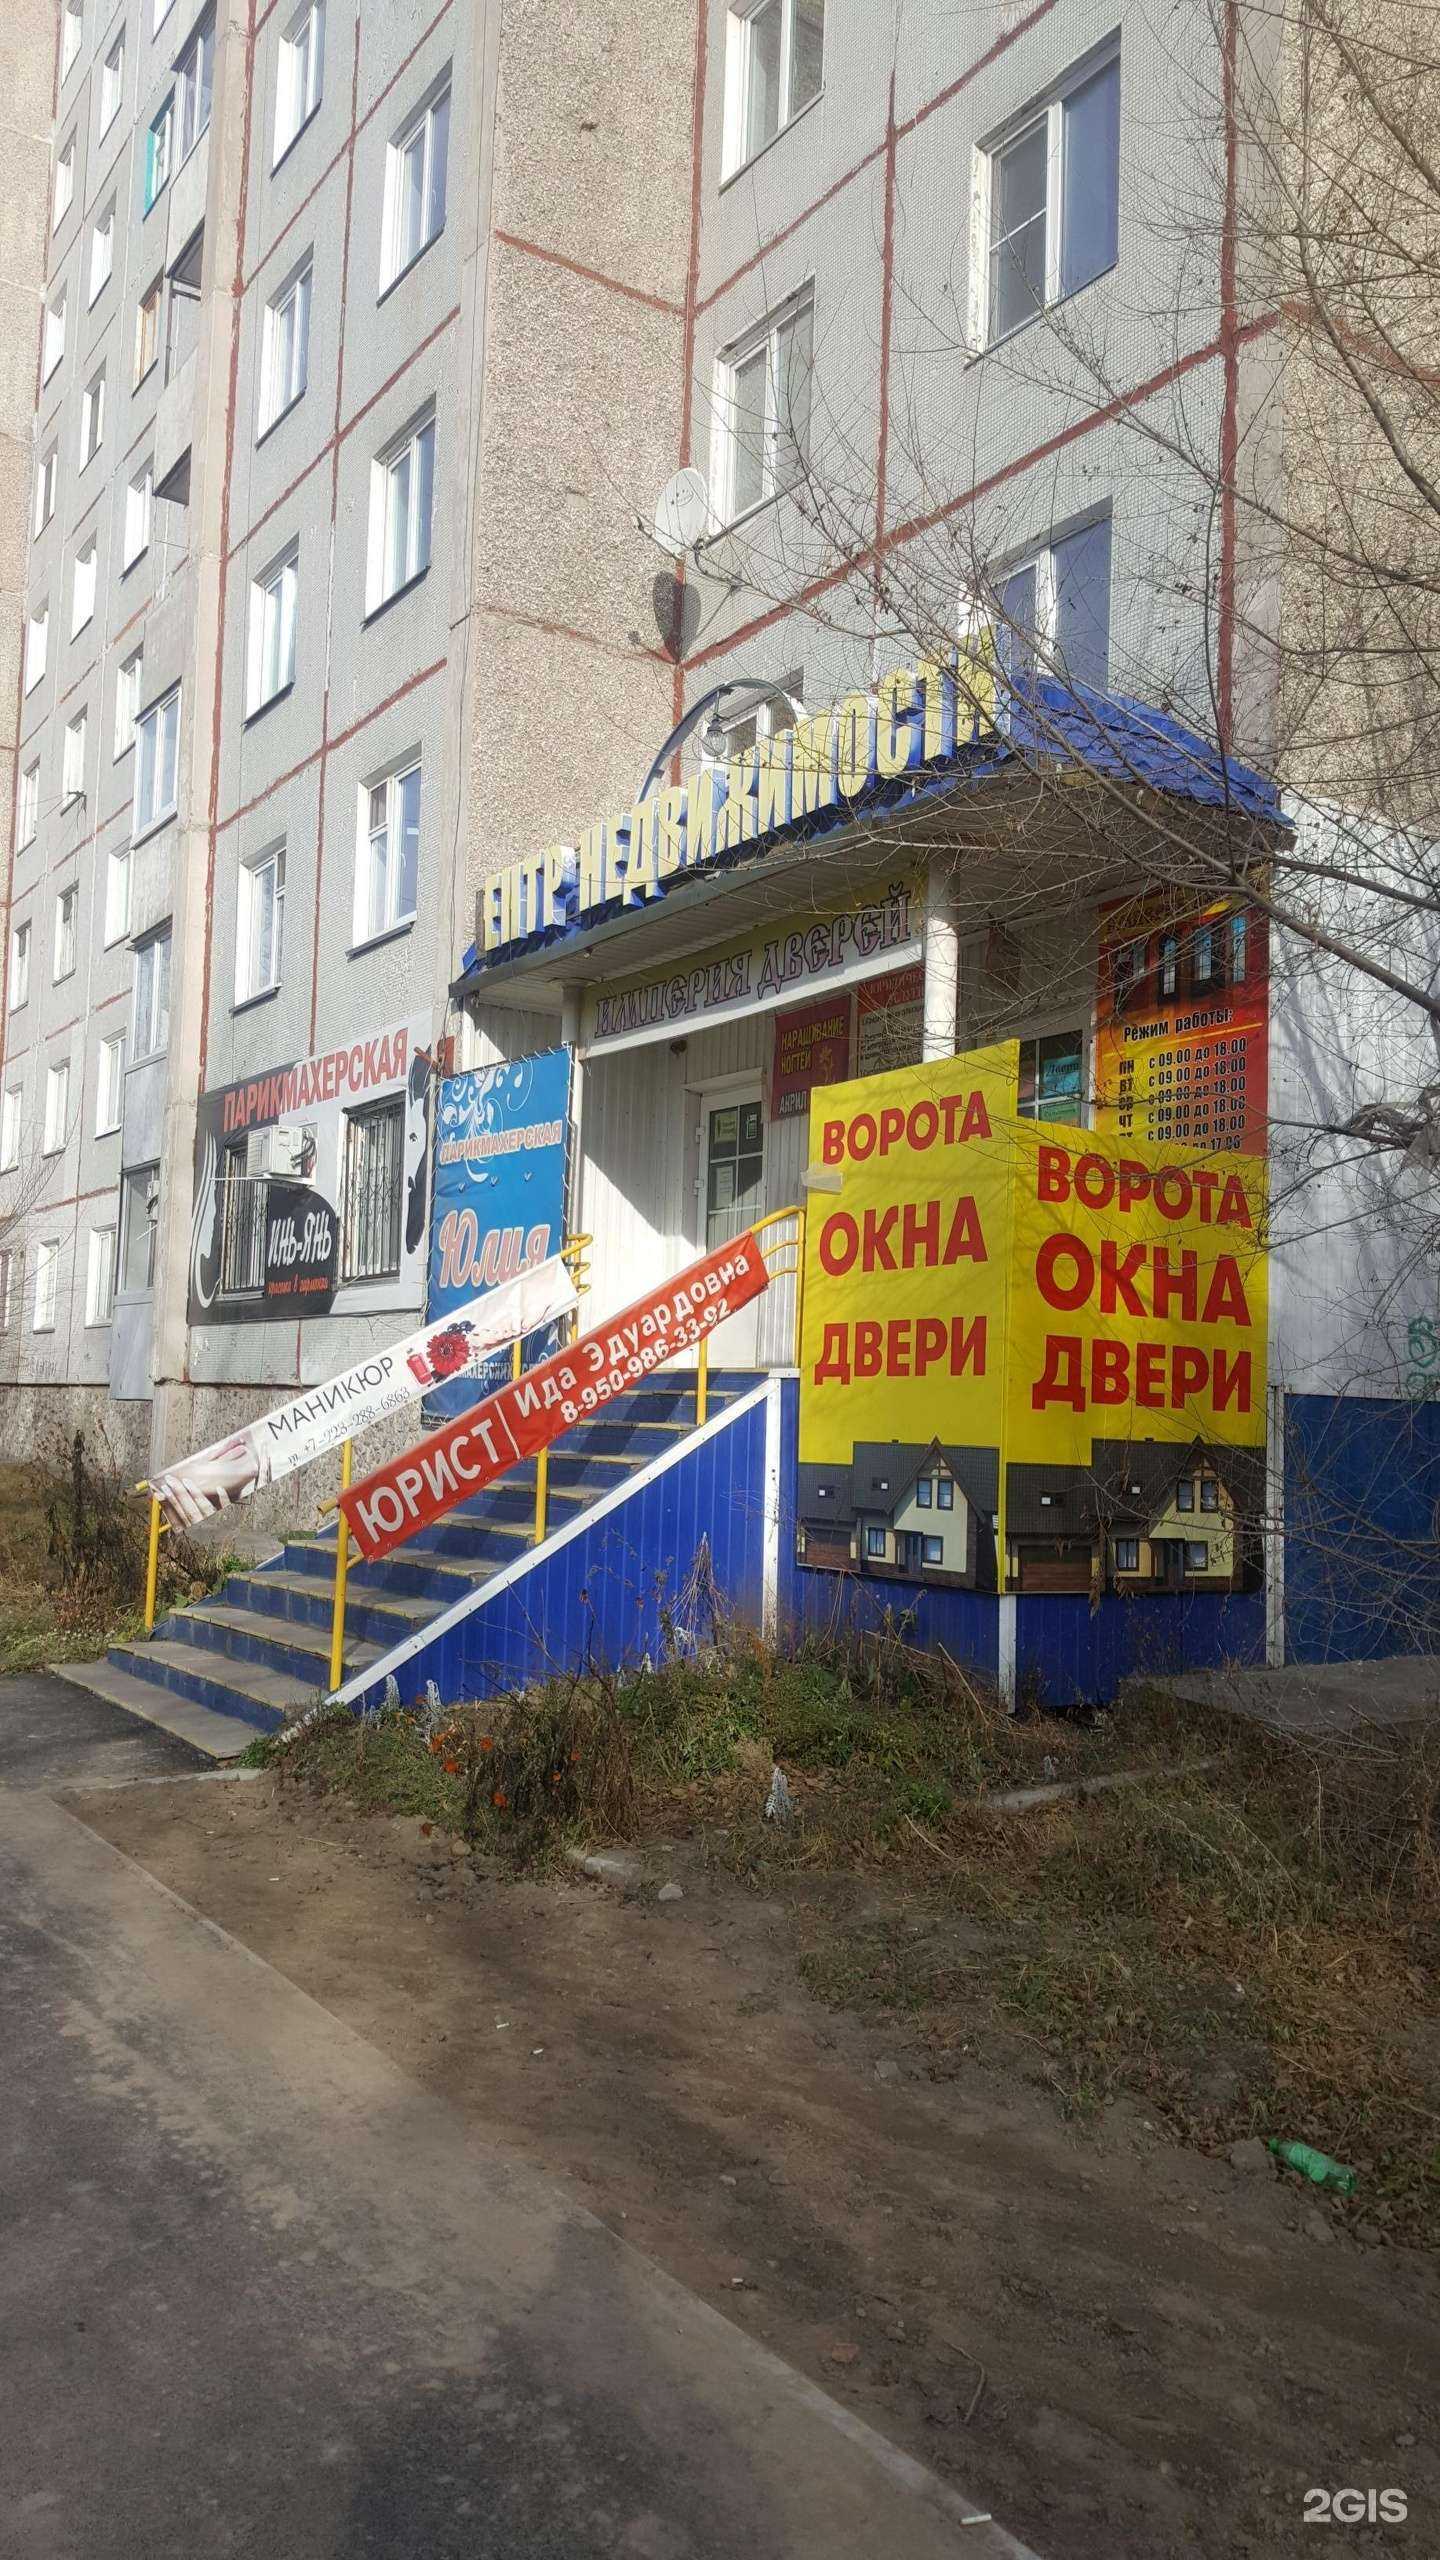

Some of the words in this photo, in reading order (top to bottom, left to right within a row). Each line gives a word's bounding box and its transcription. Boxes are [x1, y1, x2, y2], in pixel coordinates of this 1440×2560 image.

[580, 622, 1008, 912] НЕДВИЖИМОСТИ
[594, 950, 752, 1040] ИМПЕРИЯ
[757, 880, 912, 1000] ДВЕРЕЙ
[781, 1015, 845, 1050] НАРАЩИВАНИЕ
[781, 1047, 812, 1075] НОГТЕЙ
[1124, 1021, 1169, 1042] Режим
[1175, 1008, 1233, 1033] работы:
[1158, 1048, 1191, 1067] 09.00
[1195, 1047, 1210, 1062] до
[221, 1026, 409, 1132] ПАРИКМАХЕРСКАЯ
[1158, 1067, 1191, 1085] 09.00
[1195, 1066, 1210, 1080] до
[1158, 1105, 1190, 1122] 09.00
[1194, 1104, 1209, 1119] до
[1213, 1096, 1246, 1113] 18.00
[1194, 1085, 1209, 1099] до
[1214, 1076, 1246, 1094] 18.00
[439, 1120, 563, 1166] ПАРИКМАХЕРСКАЯ
[822, 1090, 992, 1165] ВОРОТА
[1157, 1123, 1190, 1141] 09.00
[1193, 1122, 1209, 1137] до
[1213, 1115, 1245, 1133] 18.00
[1037, 1145, 1253, 1229] ВОРОТА
[437, 1207, 551, 1289] Юлия
[819, 1196, 988, 1277] ОКНА
[1036, 1232, 1252, 1327] ОКНА
[513, 1367, 577, 1418] Ида
[582, 1253, 751, 1371] Эдуардовна
[560, 1299, 731, 1424] 8-950-986-33-92
[814, 1316, 987, 1386] ДВЕРИ
[1032, 1334, 1252, 1414] ДВЕРИ
[267, 1356, 394, 1440] МАНИКЮР
[354, 1418, 499, 1544] ЮРИСТ
